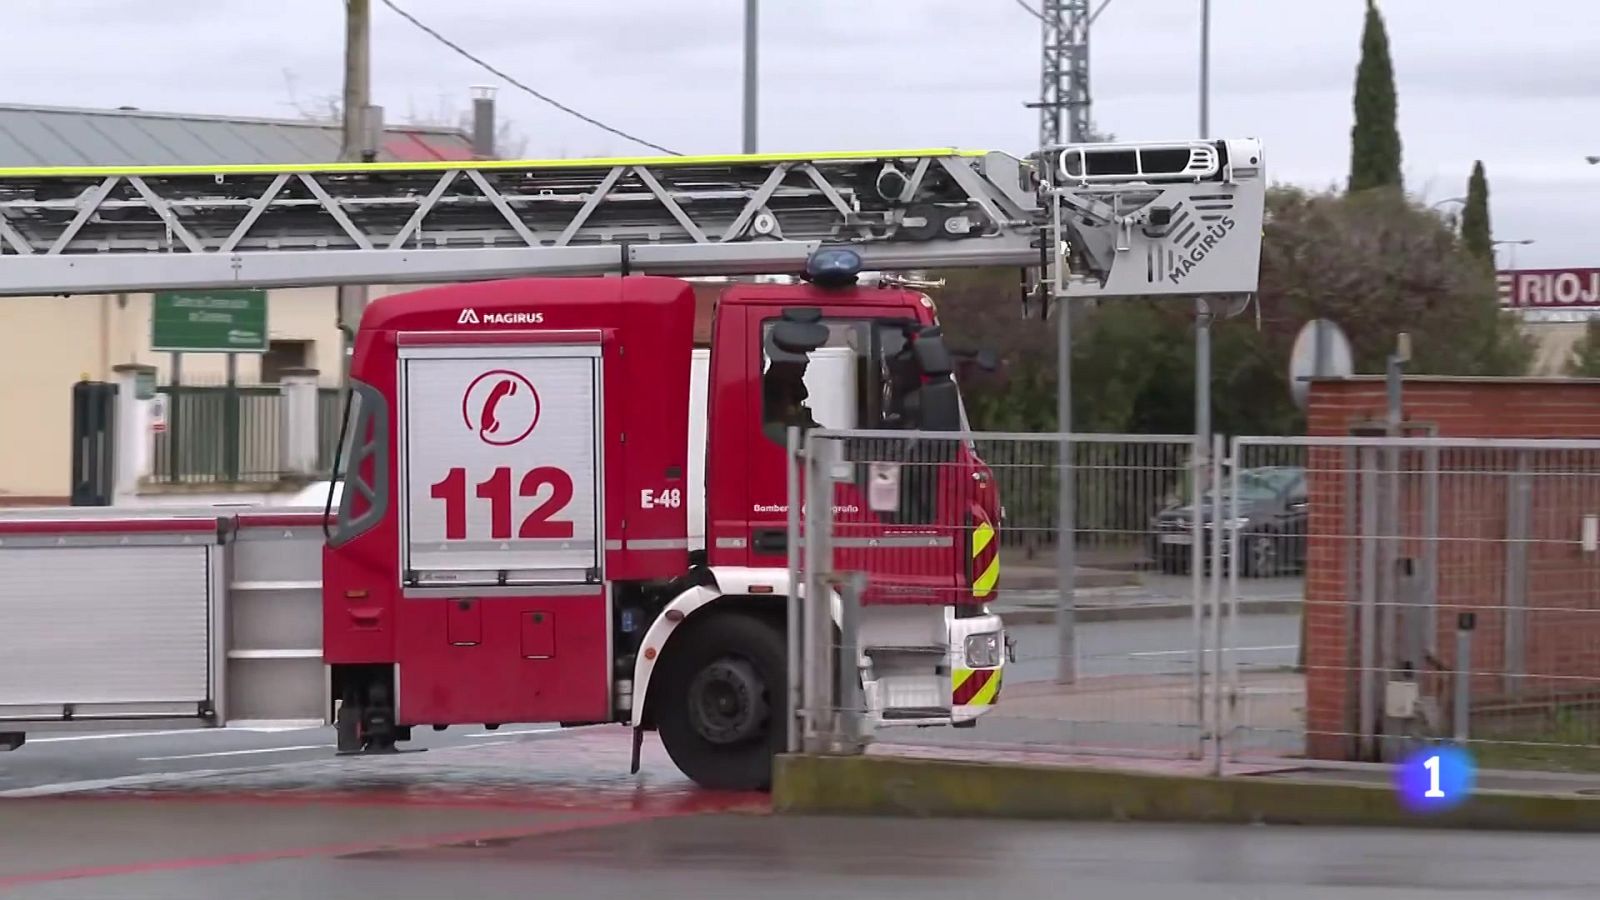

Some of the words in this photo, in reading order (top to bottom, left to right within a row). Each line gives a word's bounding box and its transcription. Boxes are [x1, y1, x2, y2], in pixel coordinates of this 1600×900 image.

[1169, 216, 1235, 284] MAGIRUS
[483, 312, 544, 324] MAGIRUS
[430, 466, 574, 540] 112
[753, 504, 789, 512] Bomber
